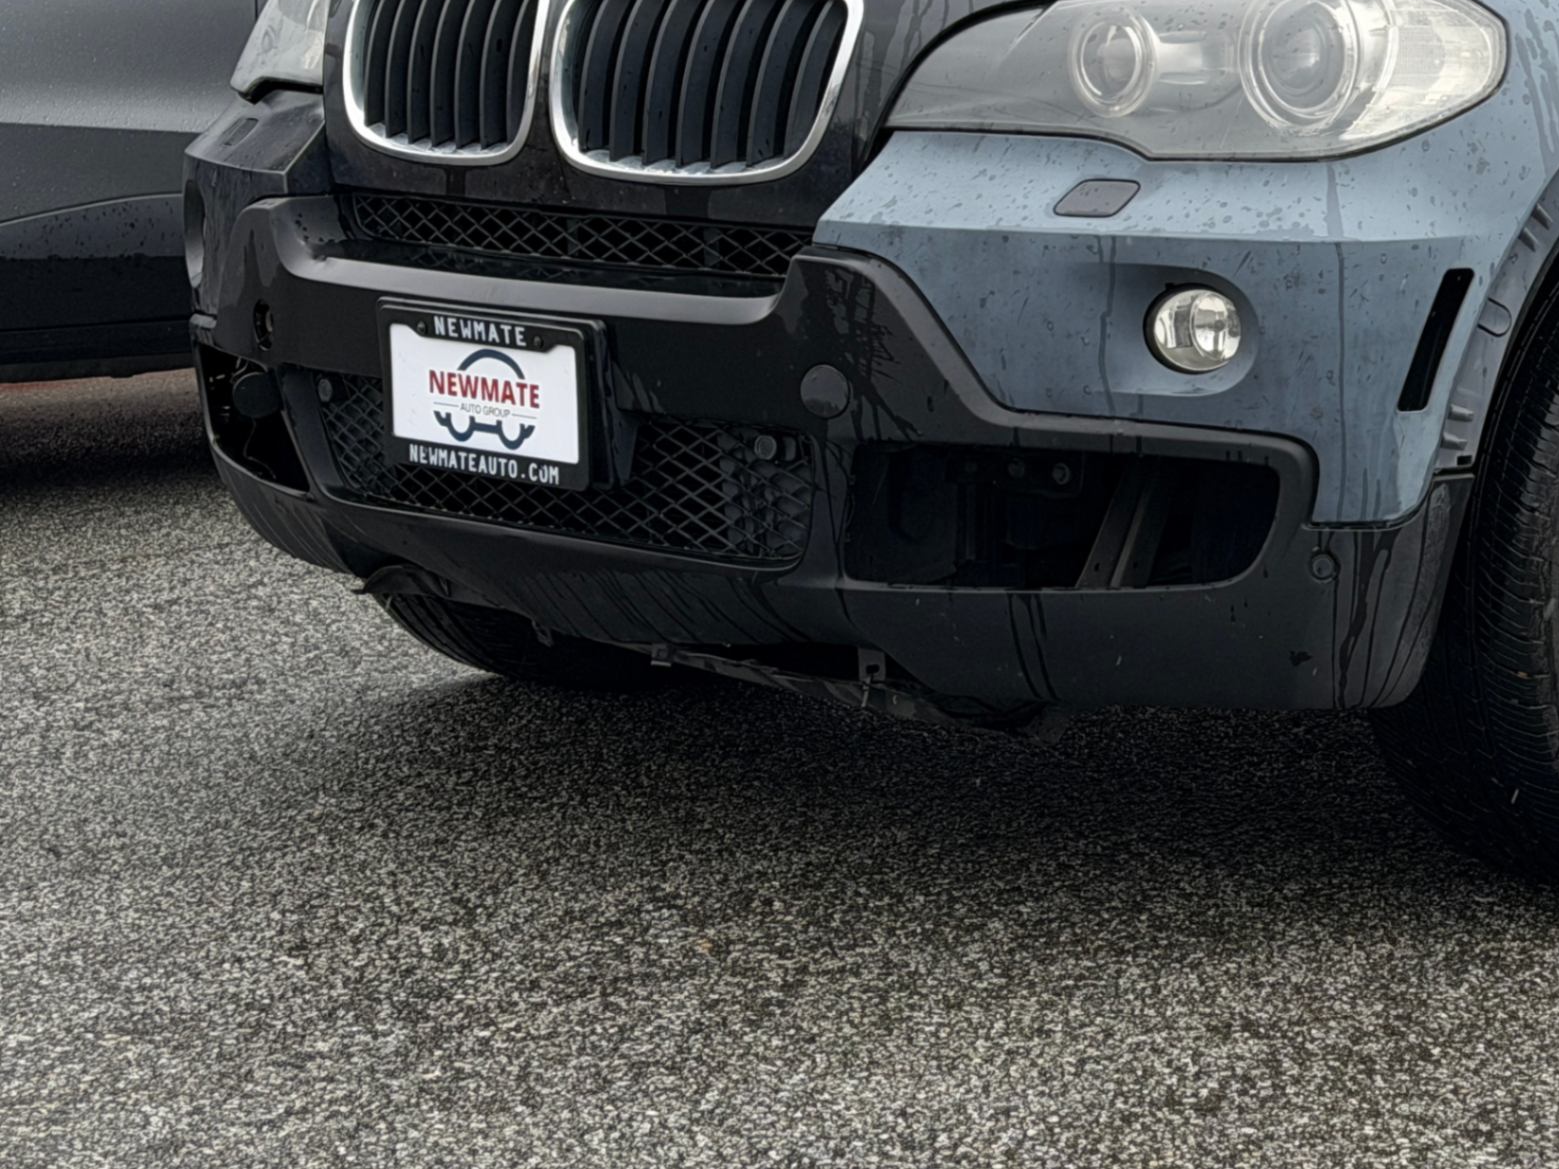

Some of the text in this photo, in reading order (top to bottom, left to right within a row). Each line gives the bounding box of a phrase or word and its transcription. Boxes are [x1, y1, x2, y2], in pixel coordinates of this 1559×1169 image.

[433, 316, 526, 346] NEWMATE
[429, 370, 540, 409] NEWMATE
[460, 402, 511, 418] AUTO GROUP
[409, 444, 559, 485] NEWMATEAUTO.COM
